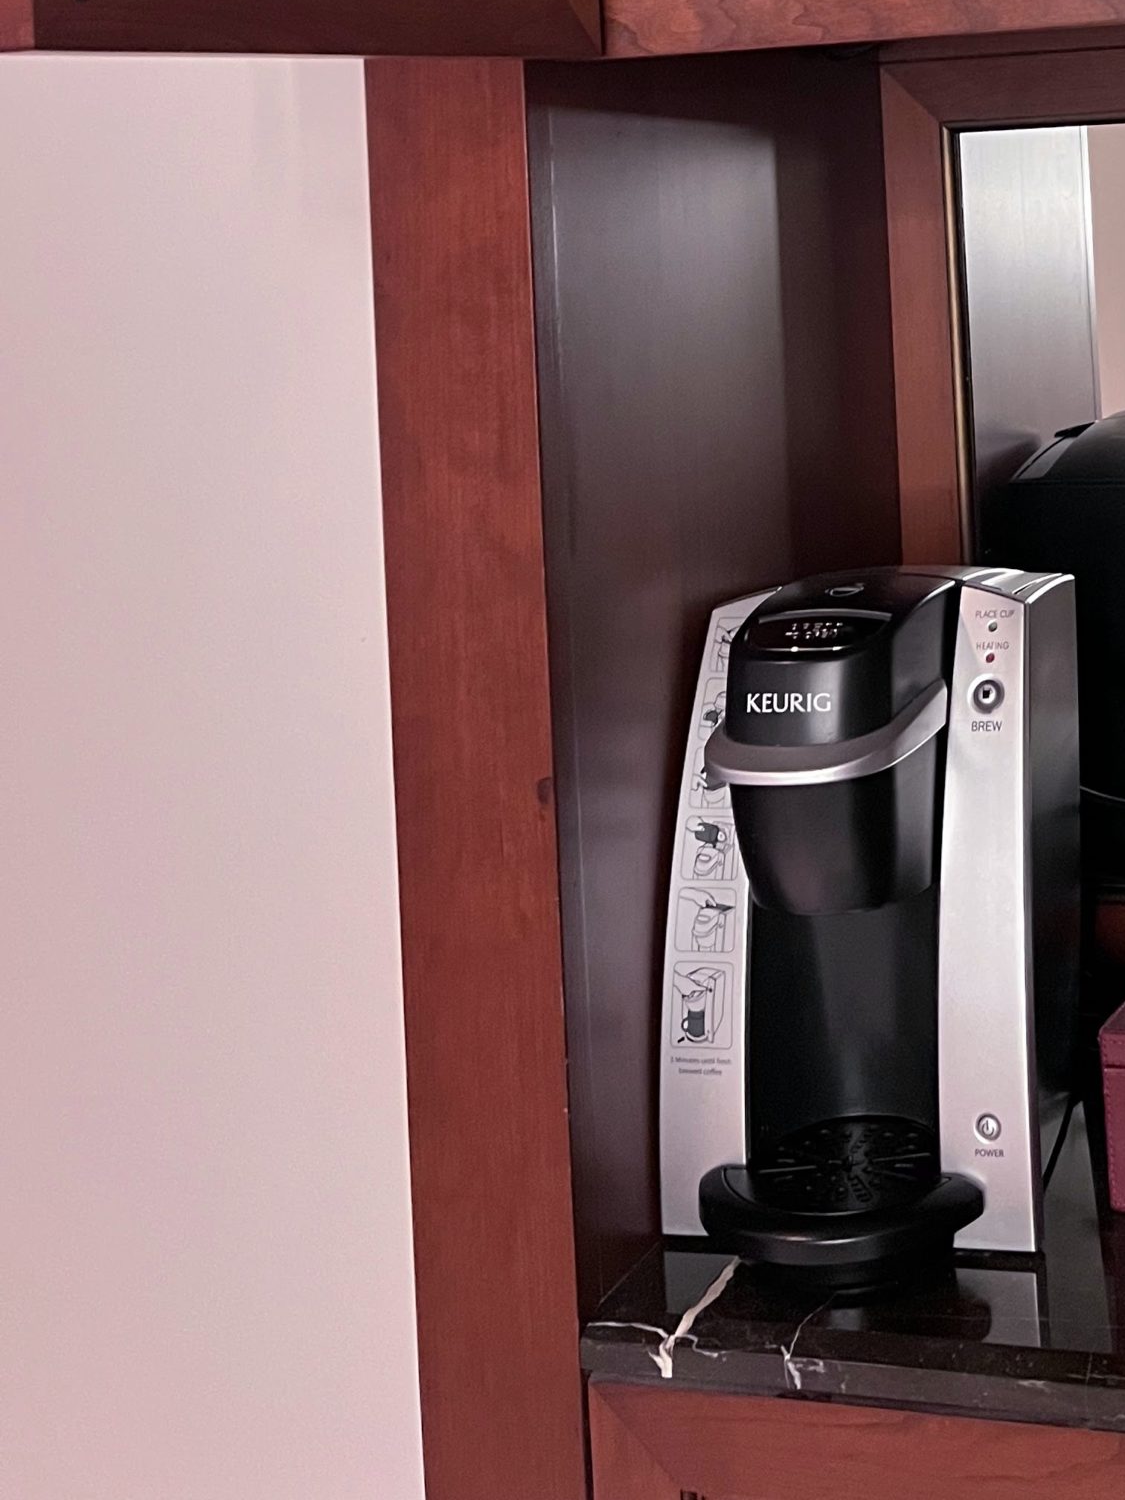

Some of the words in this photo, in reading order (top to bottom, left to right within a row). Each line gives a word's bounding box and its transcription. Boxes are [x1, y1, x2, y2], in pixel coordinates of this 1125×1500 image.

[975, 610, 998, 619] PLACE
[999, 609, 1015, 619] CUP
[975, 641, 1010, 651] HEATING
[746, 692, 832, 714] KEURIG
[971, 720, 1003, 732] BREW
[974, 1148, 1005, 1158] POWER
